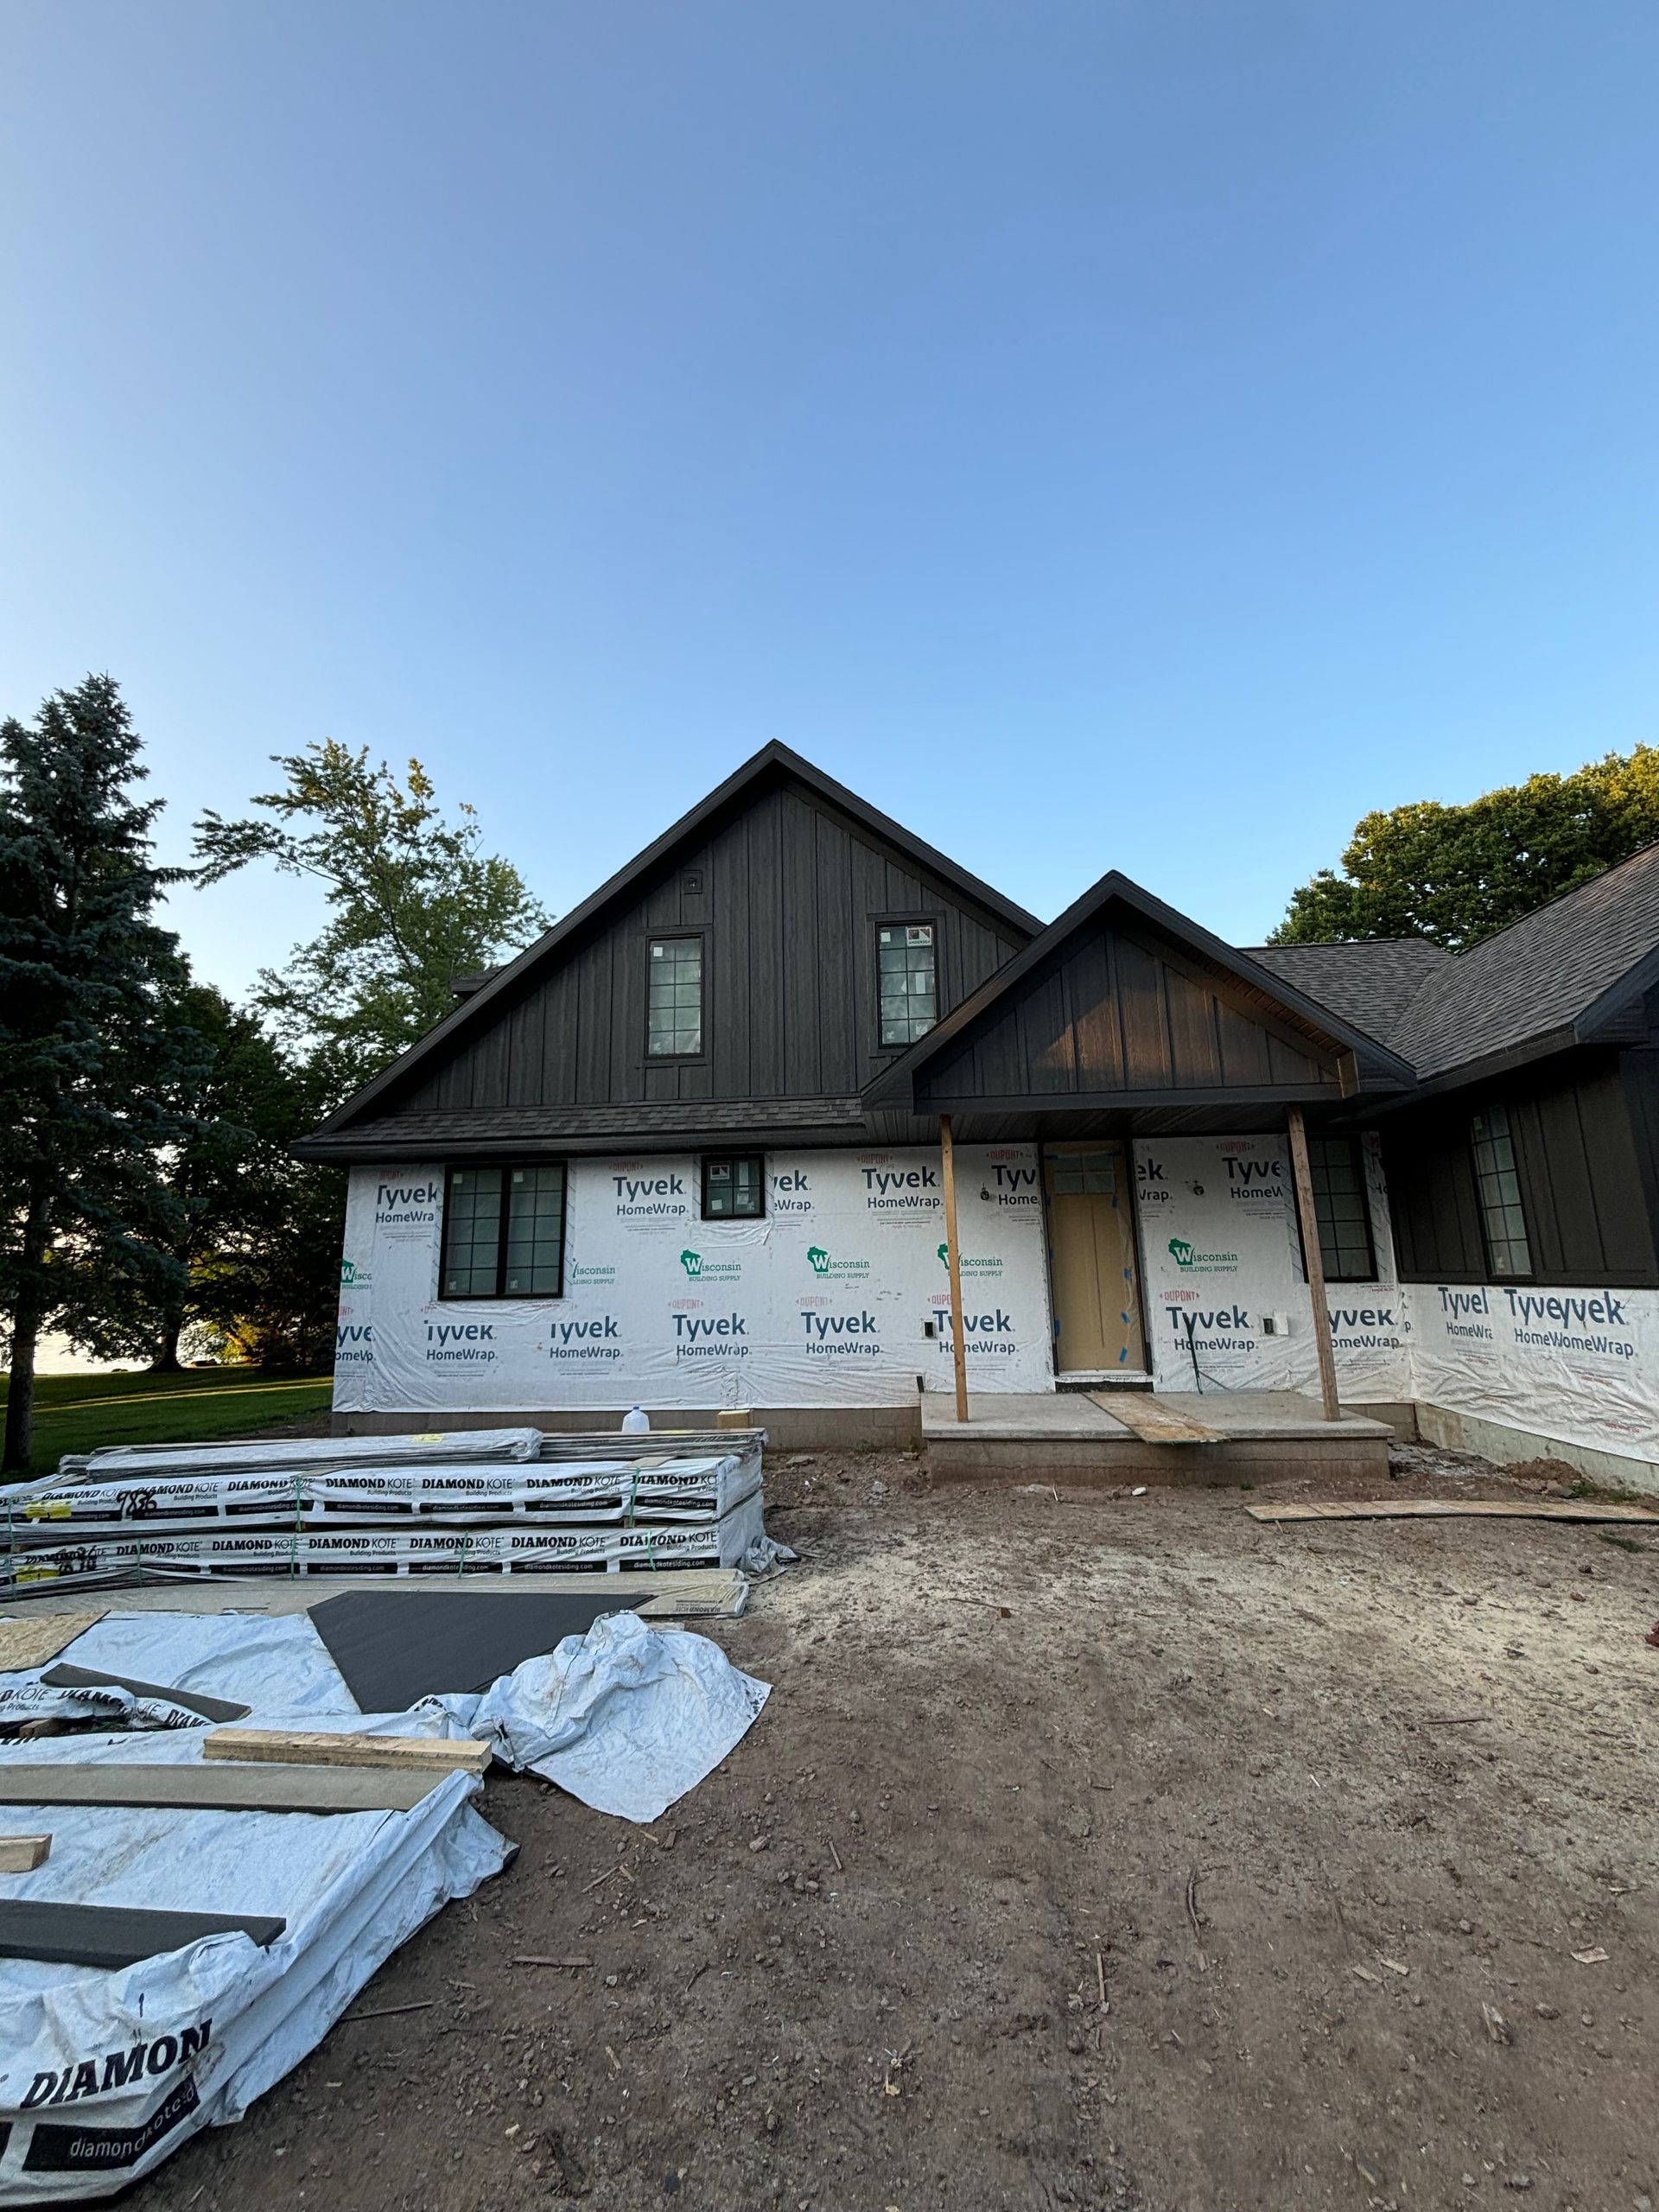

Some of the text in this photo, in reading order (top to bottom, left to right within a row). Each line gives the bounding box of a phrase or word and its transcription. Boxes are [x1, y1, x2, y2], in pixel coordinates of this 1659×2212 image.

[861, 1154, 889, 1163] DUPONT
[990, 1151, 1020, 1160] DUPONT
[1222, 1157, 1281, 1185] Tyve
[861, 1166, 937, 1194] Tyvek
[991, 1165, 1035, 1192] Tyv
[613, 1174, 684, 1202] Tyvek
[774, 1199, 811, 1213] eWrap
[868, 1196, 940, 1209] HomeWrap
[999, 1193, 1038, 1206] Home
[616, 1204, 686, 1217] HomeWrap
[376, 1211, 434, 1224] HomeWra
[1173, 1247, 1238, 1265] Wisconsin
[684, 1256, 741, 1274] Wisconsin
[812, 1254, 870, 1272] Wisconsin
[573, 1262, 615, 1278] isconsin
[800, 1297, 829, 1306] DUPONT
[1164, 1290, 1196, 1301] DUPONT
[671, 1299, 701, 1309] DUPONT
[672, 1313, 747, 1342] Tyvek
[801, 1311, 877, 1340] Tyvek
[1166, 1305, 1249, 1337] Tyvek
[1327, 1309, 1395, 1333] yvek
[805, 1342, 880, 1356] HomeWrap
[1174, 1338, 1255, 1352] HomeWrap
[1331, 1336, 1400, 1350] omeWrap
[426, 1349, 495, 1363] HomeWrap
[550, 1347, 620, 1360] HomeWrap
[677, 1344, 749, 1357] HomeWrap
[227, 1480, 288, 1491] DIAMOND
[326, 1478, 385, 1489] DIAMOND
[387, 1478, 412, 1489] KOTE
[422, 1478, 512, 1489] DIAMOND KOTE
[526, 1475, 620, 1488] DIAMOND KOTE
[632, 1475, 698, 1485] DIAMOND
[194, 1483, 219, 1493] KOTE
[43, 1490, 100, 1500] DIAMOND
[212, 1540, 273, 1551] DIAMOND
[308, 1538, 397, 1549] DIAMOND KOTE
[410, 1537, 501, 1548] DIAMOND KOTE
[512, 1536, 606, 1548] DIAMOND KOTE
[620, 1532, 717, 1547] DIAMOND KOTE
[117, 1541, 200, 1555] DIAMOND KOTE
[20, 2018, 213, 2109] DIAMON
